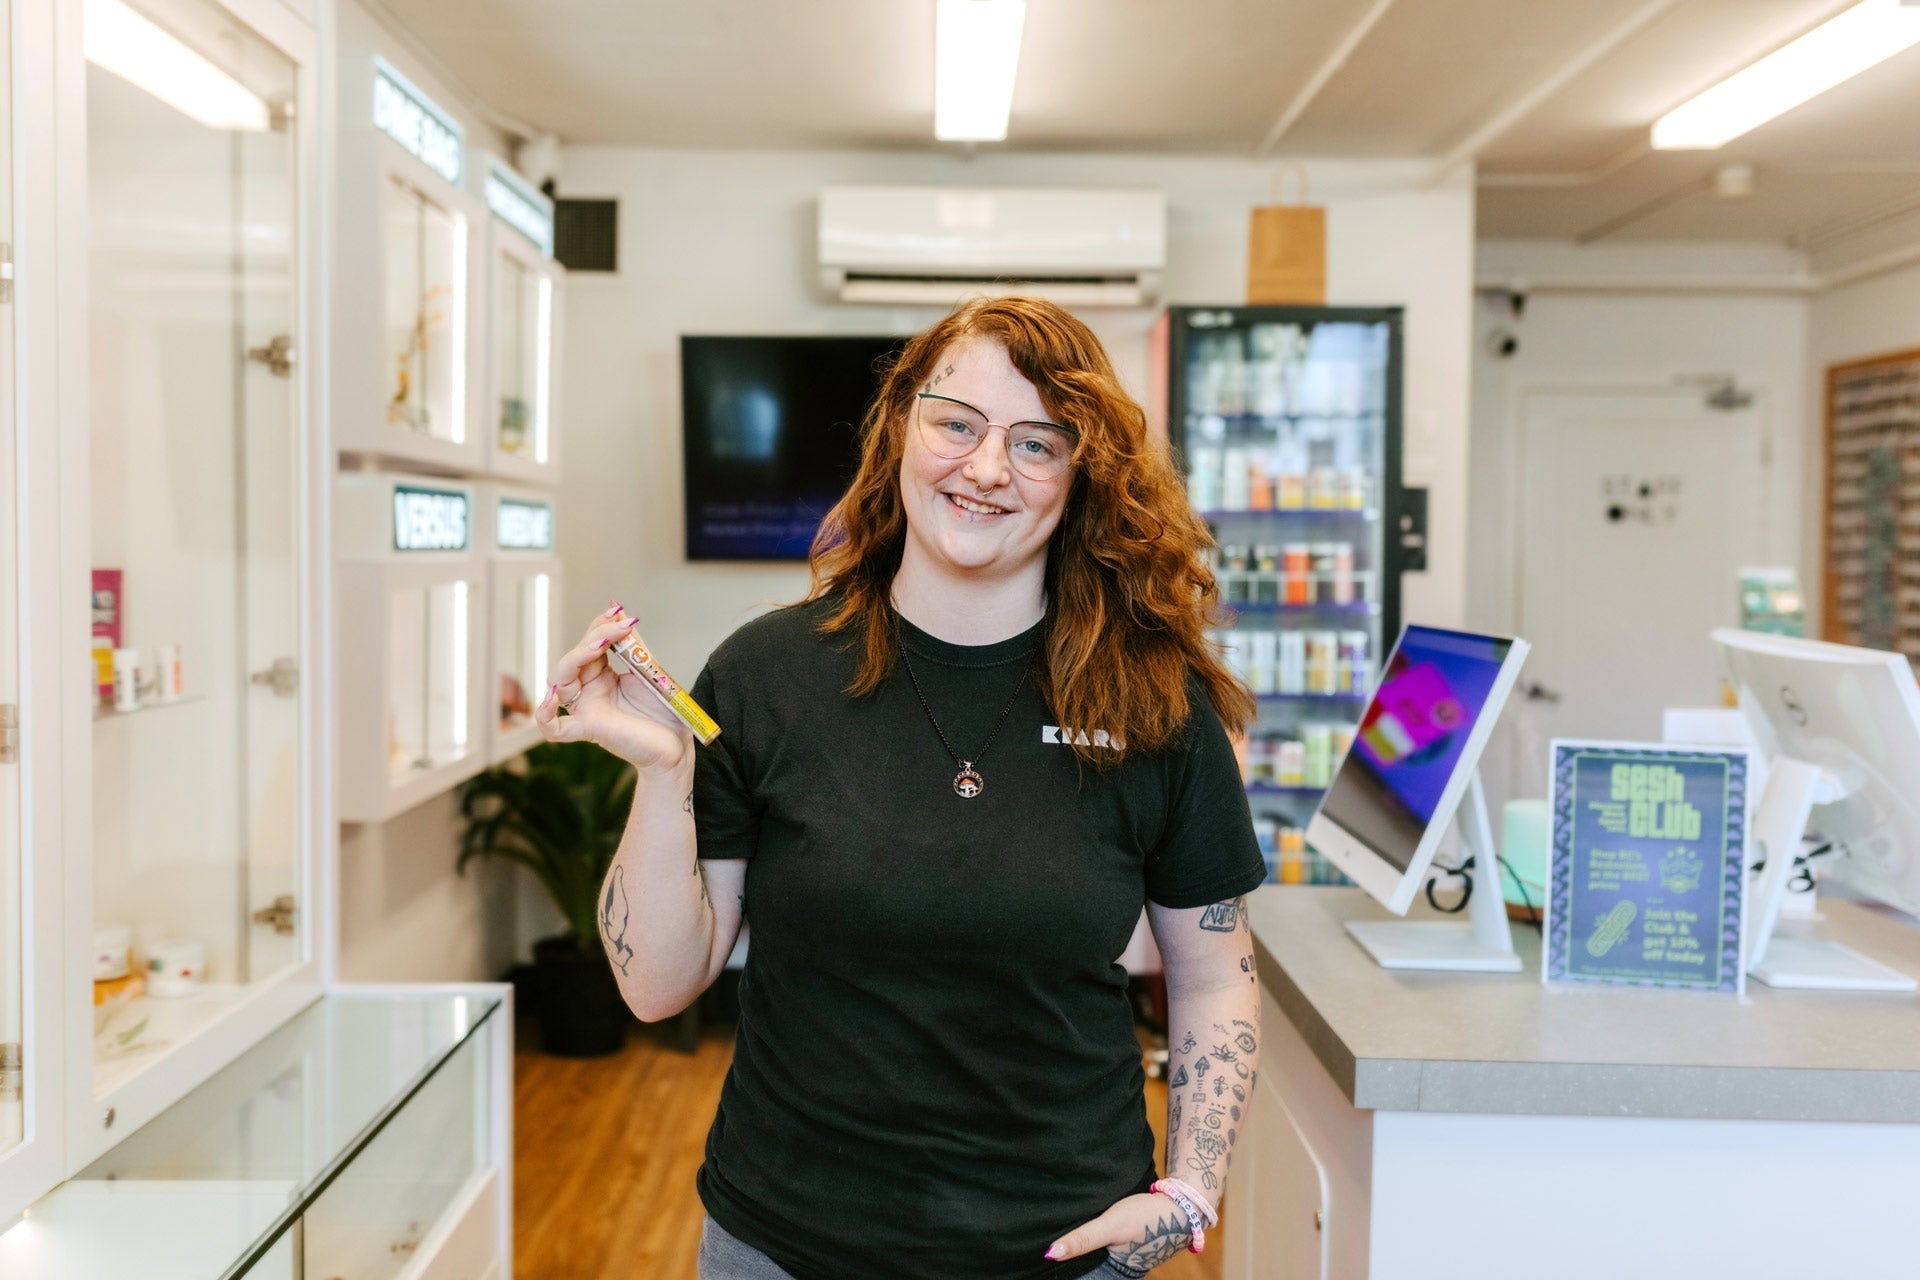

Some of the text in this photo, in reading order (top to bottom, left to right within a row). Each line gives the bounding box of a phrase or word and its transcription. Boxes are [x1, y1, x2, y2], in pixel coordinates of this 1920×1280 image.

[394, 493, 466, 549] VERSUS
[1644, 908, 1698, 922] Join the
[1643, 921, 1690, 935] Club &
[1642, 937, 1666, 949] get
[1642, 949, 1706, 966] off today
